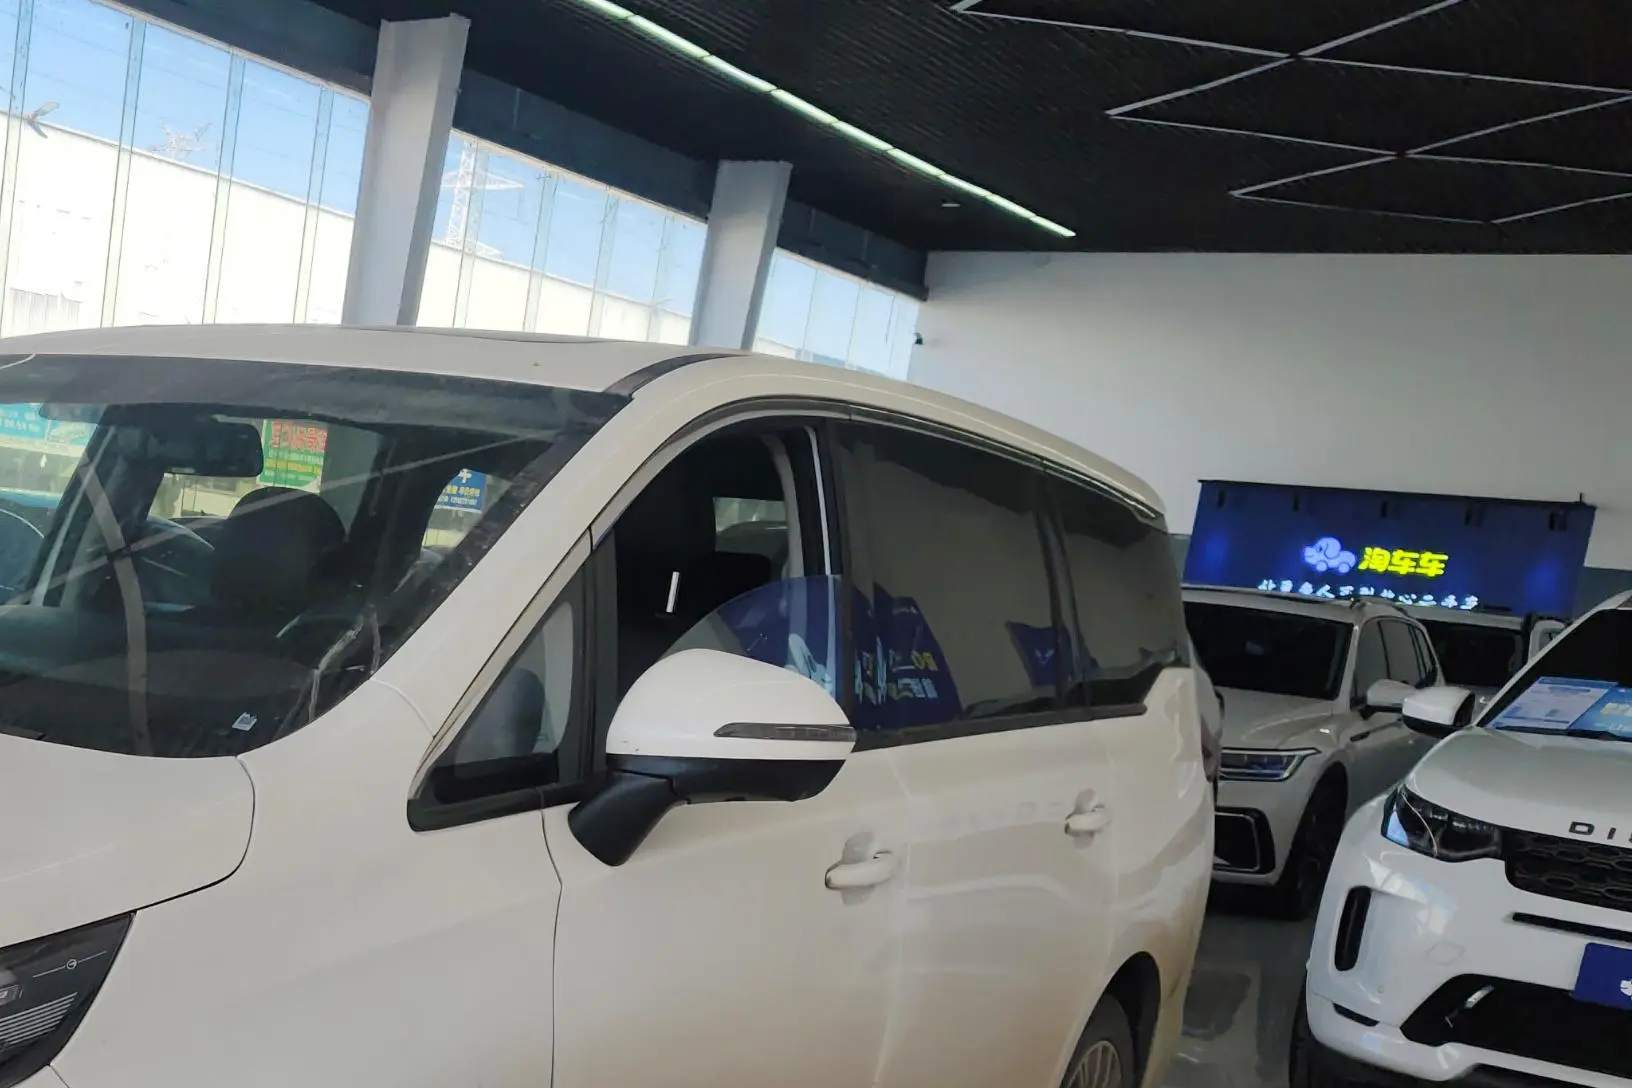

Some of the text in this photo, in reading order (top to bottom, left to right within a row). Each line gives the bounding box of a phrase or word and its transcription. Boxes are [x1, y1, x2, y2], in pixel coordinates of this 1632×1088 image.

[1358, 547, 1449, 577] 淘车车
[1569, 821, 1632, 843] DI
